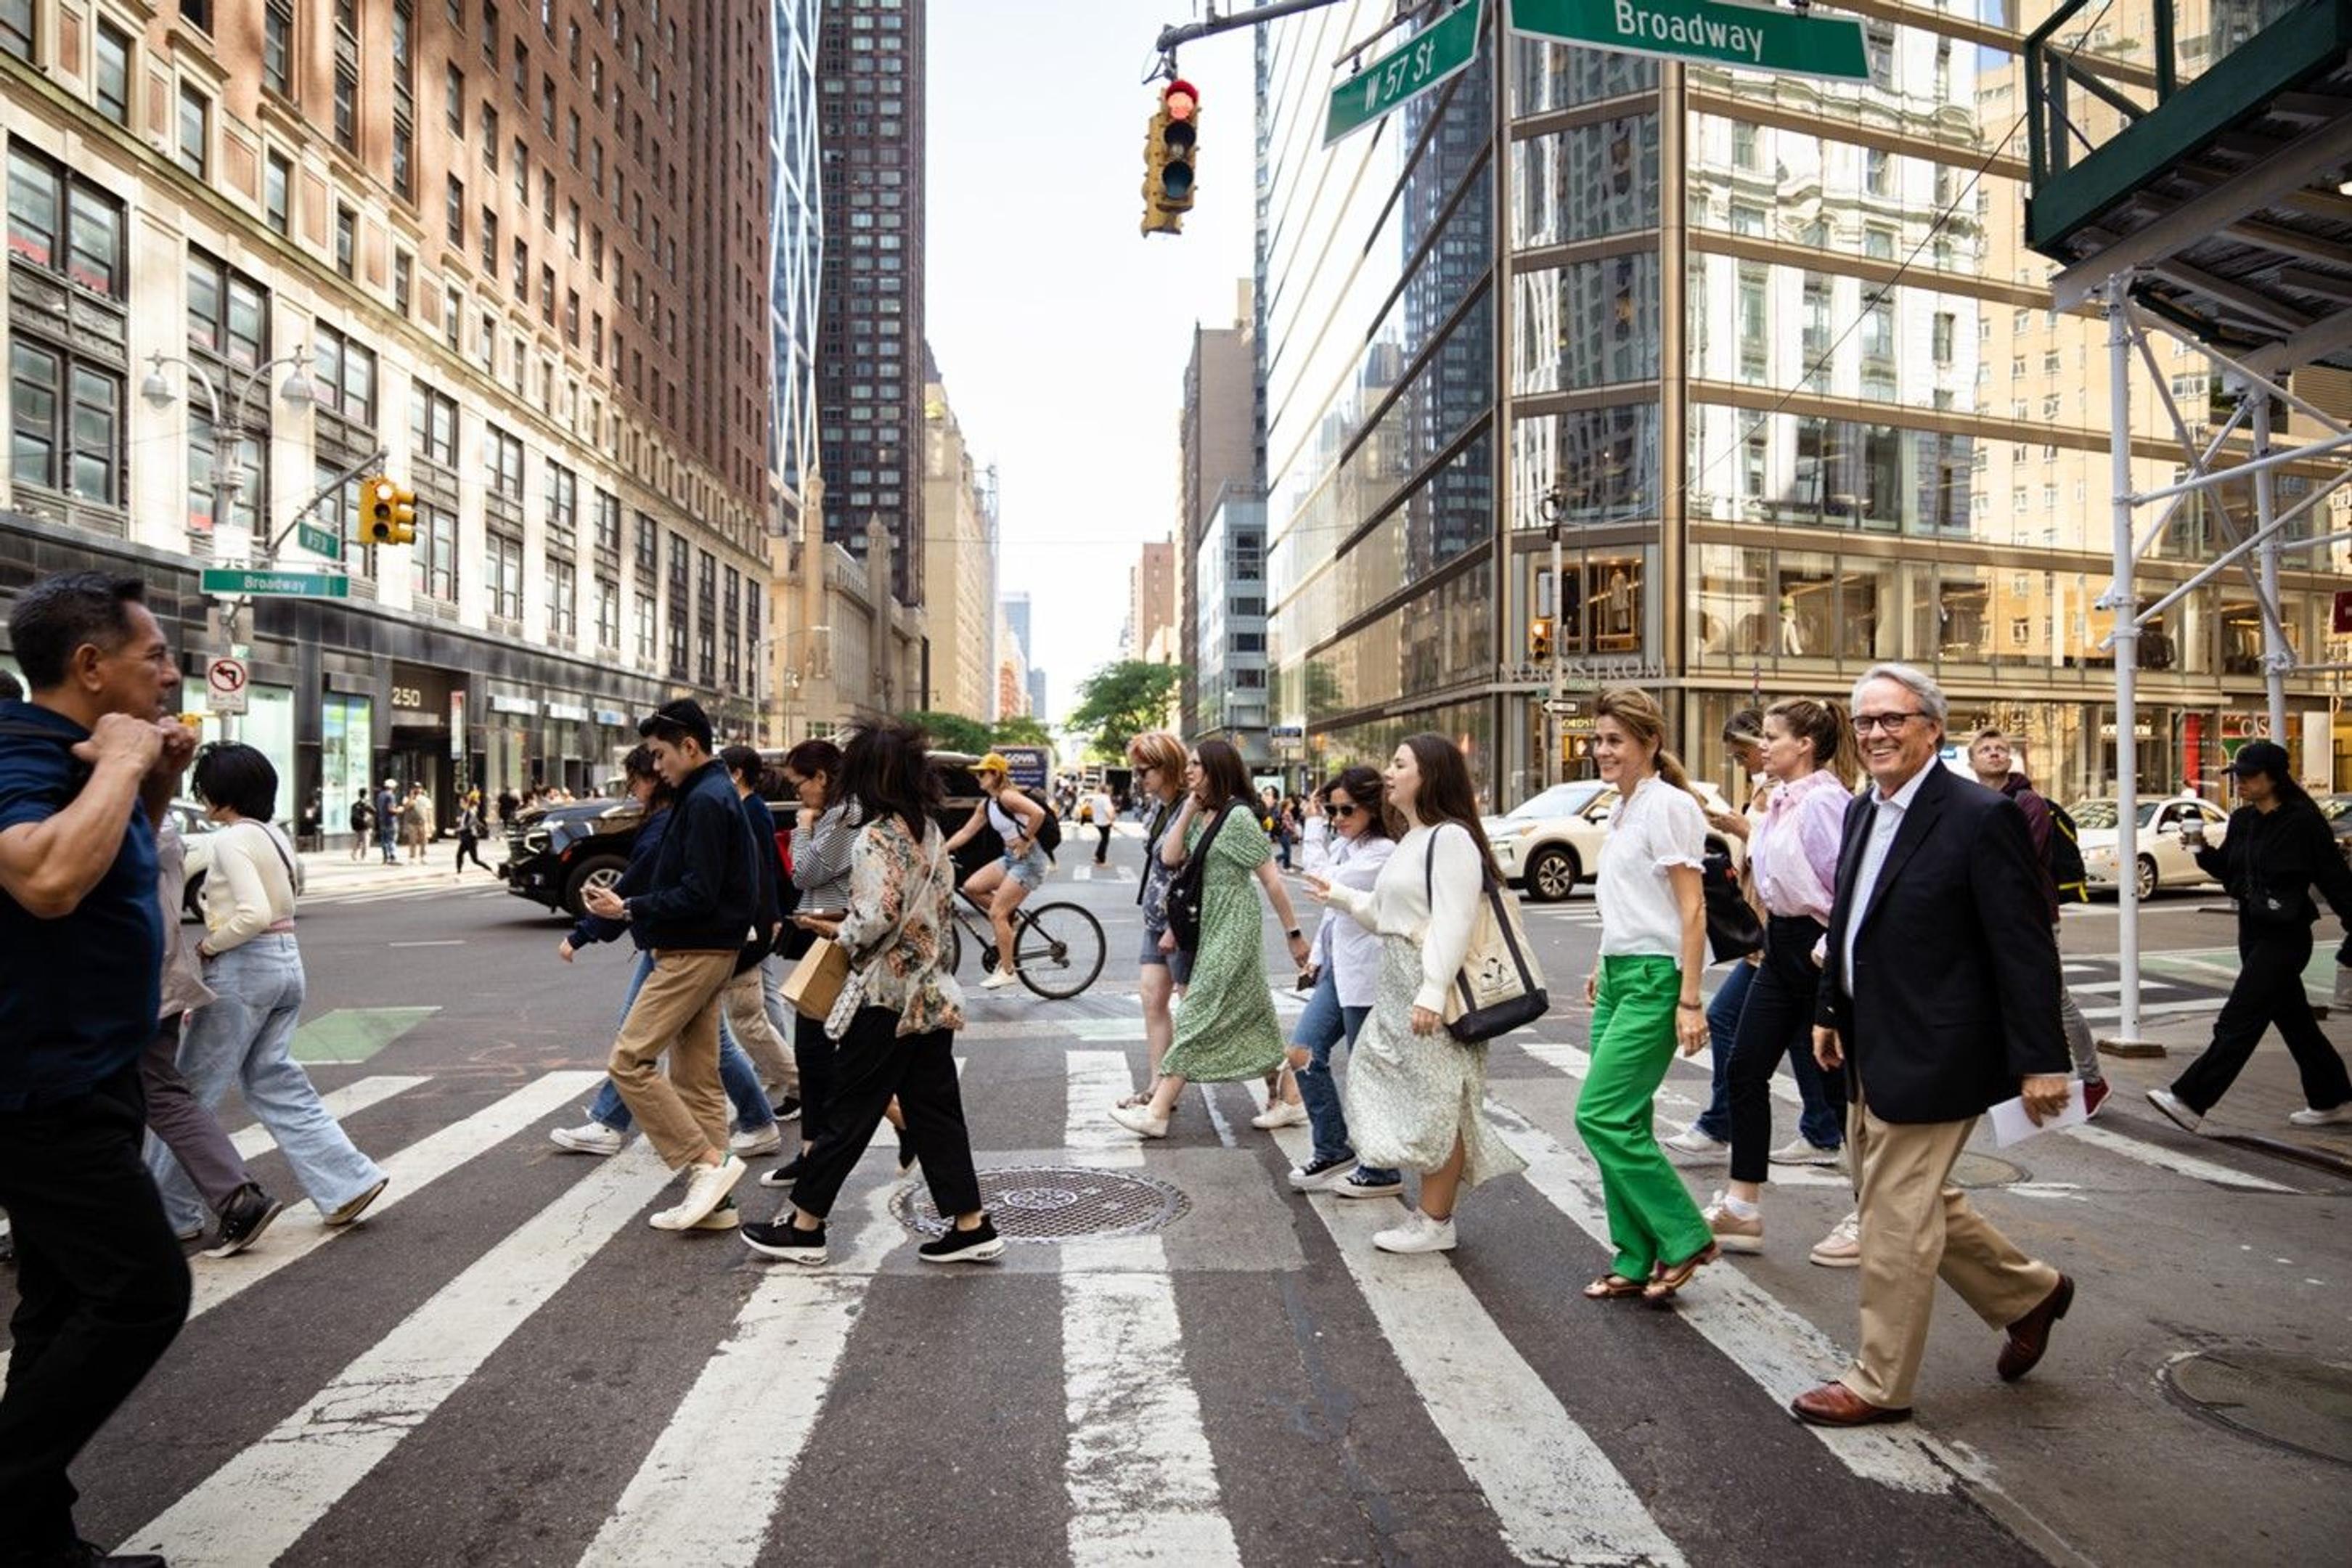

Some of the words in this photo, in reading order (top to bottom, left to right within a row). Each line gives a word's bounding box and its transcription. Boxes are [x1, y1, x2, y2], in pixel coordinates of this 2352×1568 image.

[1614, 0, 1763, 62] Broadway
[1365, 72, 1381, 111] W
[1384, 54, 1409, 101] 57
[1413, 37, 1435, 82] St
[244, 575, 306, 593] Broadway
[391, 687, 421, 707] 250
